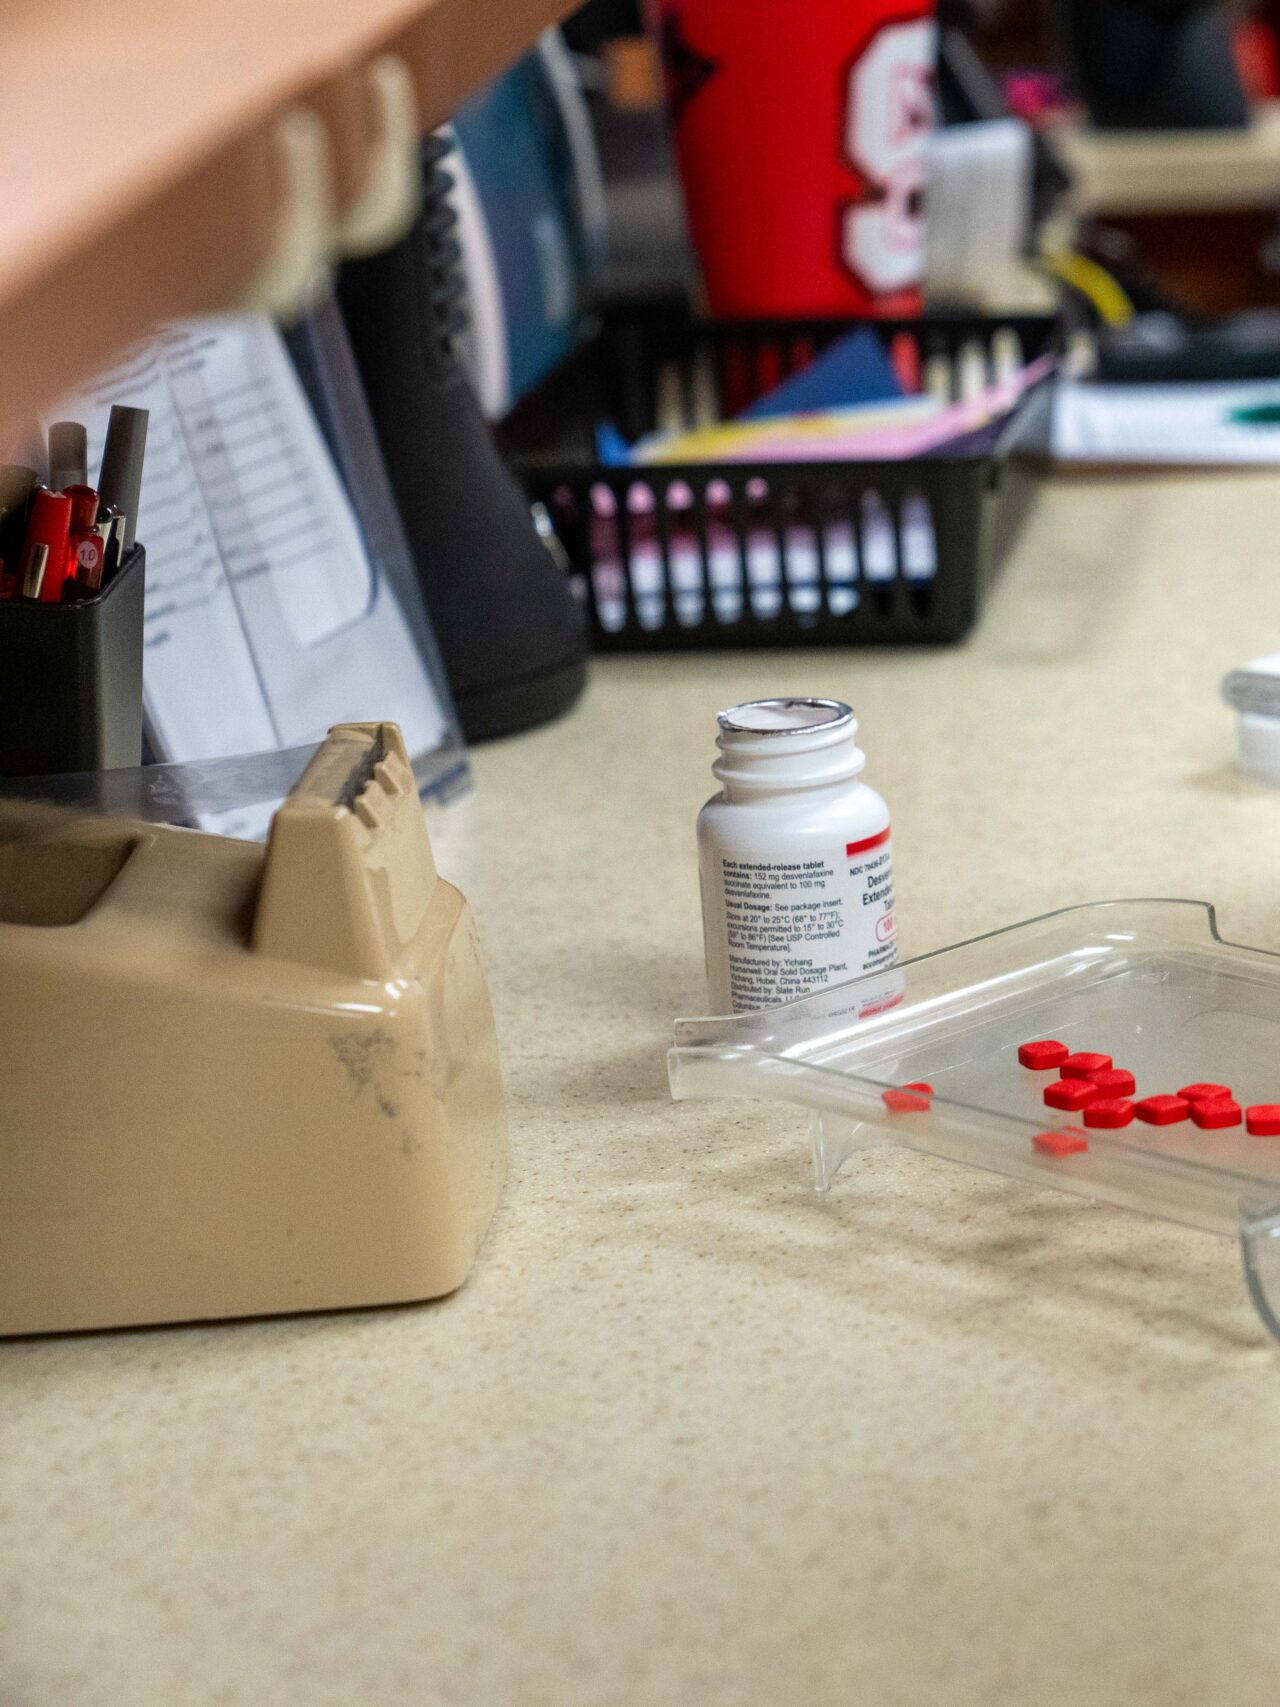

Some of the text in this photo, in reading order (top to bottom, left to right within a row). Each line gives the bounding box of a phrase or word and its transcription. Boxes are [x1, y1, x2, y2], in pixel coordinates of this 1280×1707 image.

[79, 548, 96, 562] 1.0
[723, 859, 824, 871] Each extended-release tablet
[849, 865, 863, 876] NDC
[723, 870, 751, 879] contains:
[768, 874, 779, 882] mg
[782, 869, 834, 880] desvenlafaxine
[753, 882, 788, 892] equivalent
[800, 880, 812, 888] 100
[814, 880, 825, 888] mg
[725, 899, 742, 909] Usual
[744, 902, 772, 913] Dosage:
[790, 902, 820, 912] package
[823, 899, 843, 908] insert.
[726, 911, 741, 921] Store
[750, 915, 761, 923] 20°
[772, 915, 790, 923] 25°C
[727, 922, 758, 932] excursions
[760, 925, 792, 935] permitted
[804, 923, 815, 931] 15°
[826, 920, 844, 929] 30°C
[740, 932, 747, 940] to
[768, 933, 784, 943] [See
[786, 933, 803, 942] USP
[804, 931, 840, 941] Controlled
[728, 939, 744, 948] Room
[729, 954, 770, 966] Manufactured
[783, 959, 813, 967] Yichang
[763, 967, 778, 975] Oral
[780, 967, 797, 975] Solid
[800, 967, 827, 976] Dosage
[780, 977, 800, 985] China
[802, 975, 828, 984] 443112
[731, 982, 761, 992] Distributed
[776, 986, 793, 994] Slate
